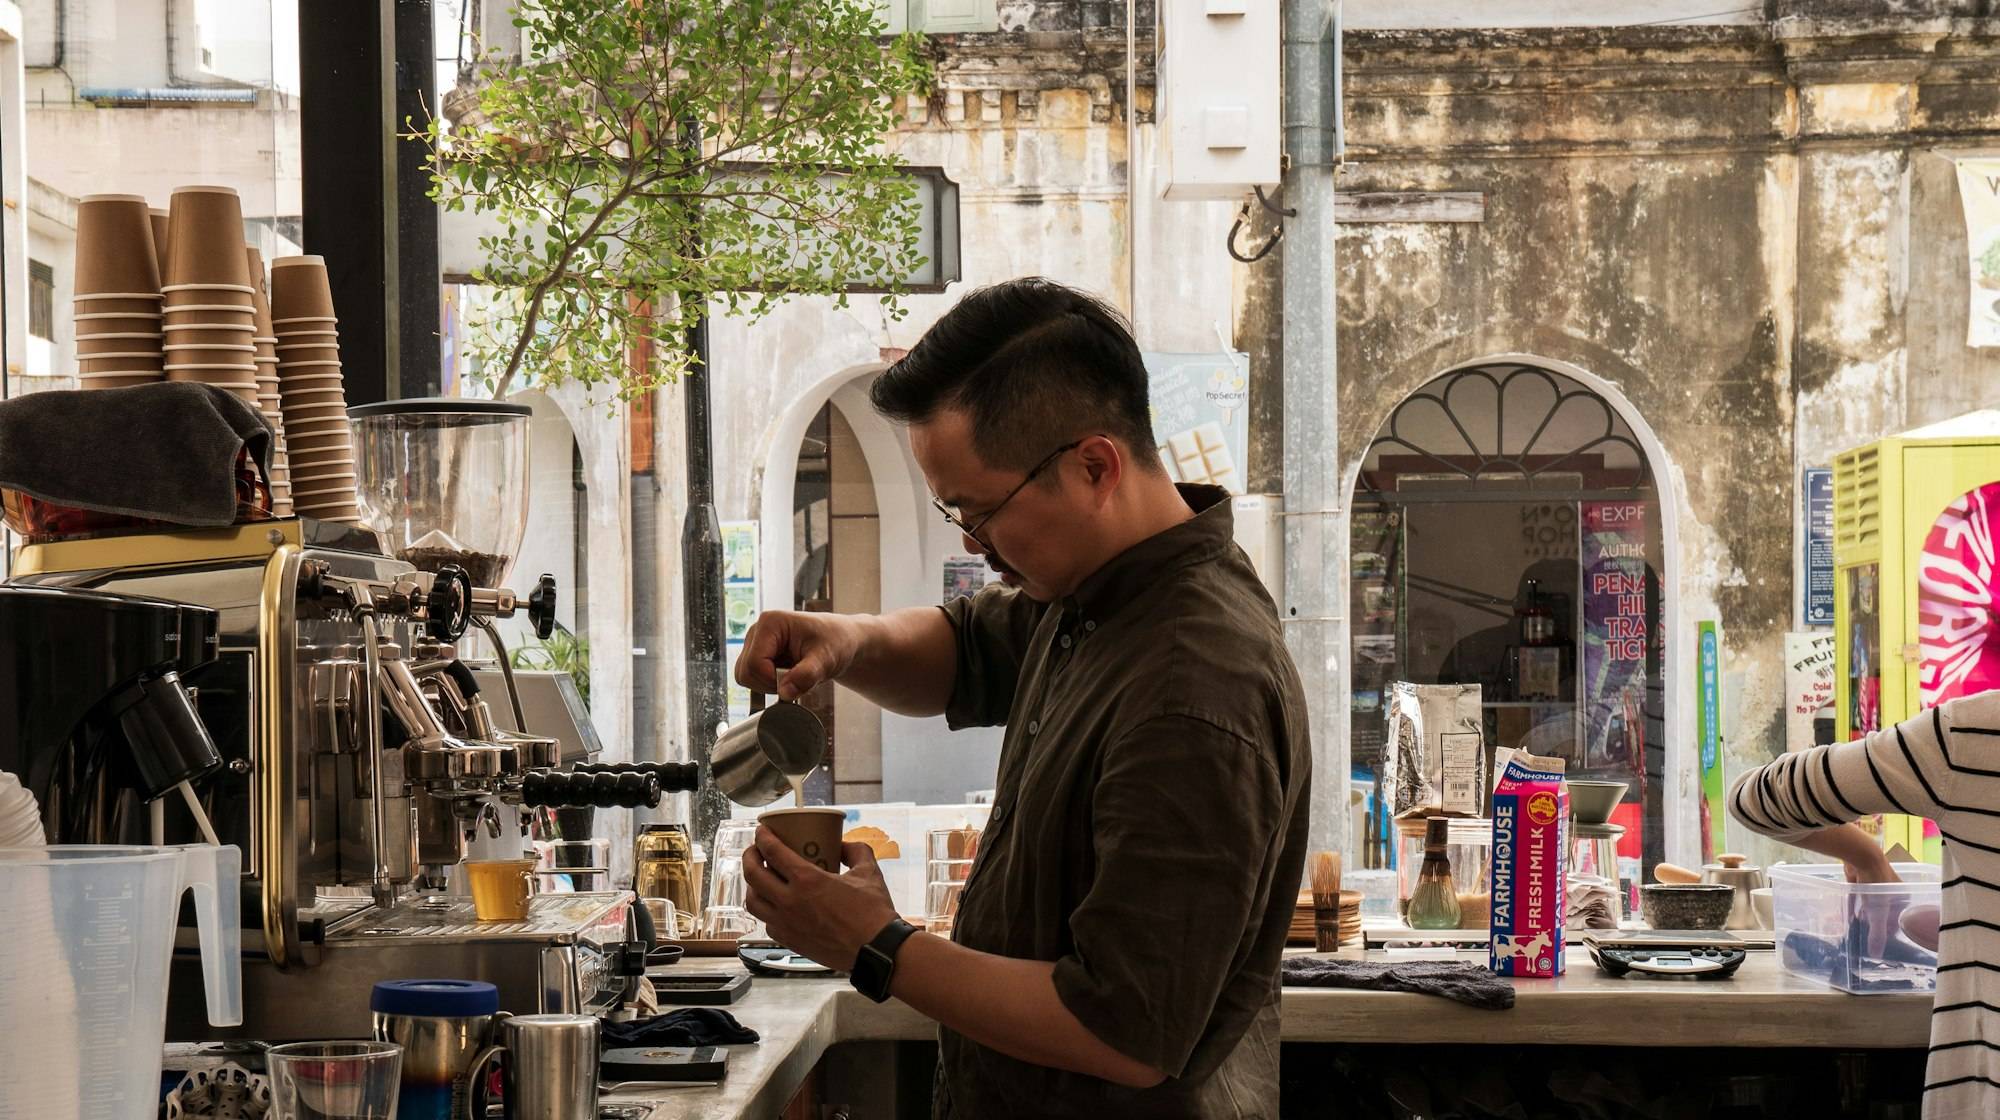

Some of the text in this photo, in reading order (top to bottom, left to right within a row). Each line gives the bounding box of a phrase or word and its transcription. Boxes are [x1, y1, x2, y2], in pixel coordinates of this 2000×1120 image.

[1508, 767, 1560, 780] FARMHOUSE
[1496, 807, 1512, 928] FARMHOUSE
[1530, 826, 1544, 871] MILK
[1528, 872, 1544, 929] FRESH
